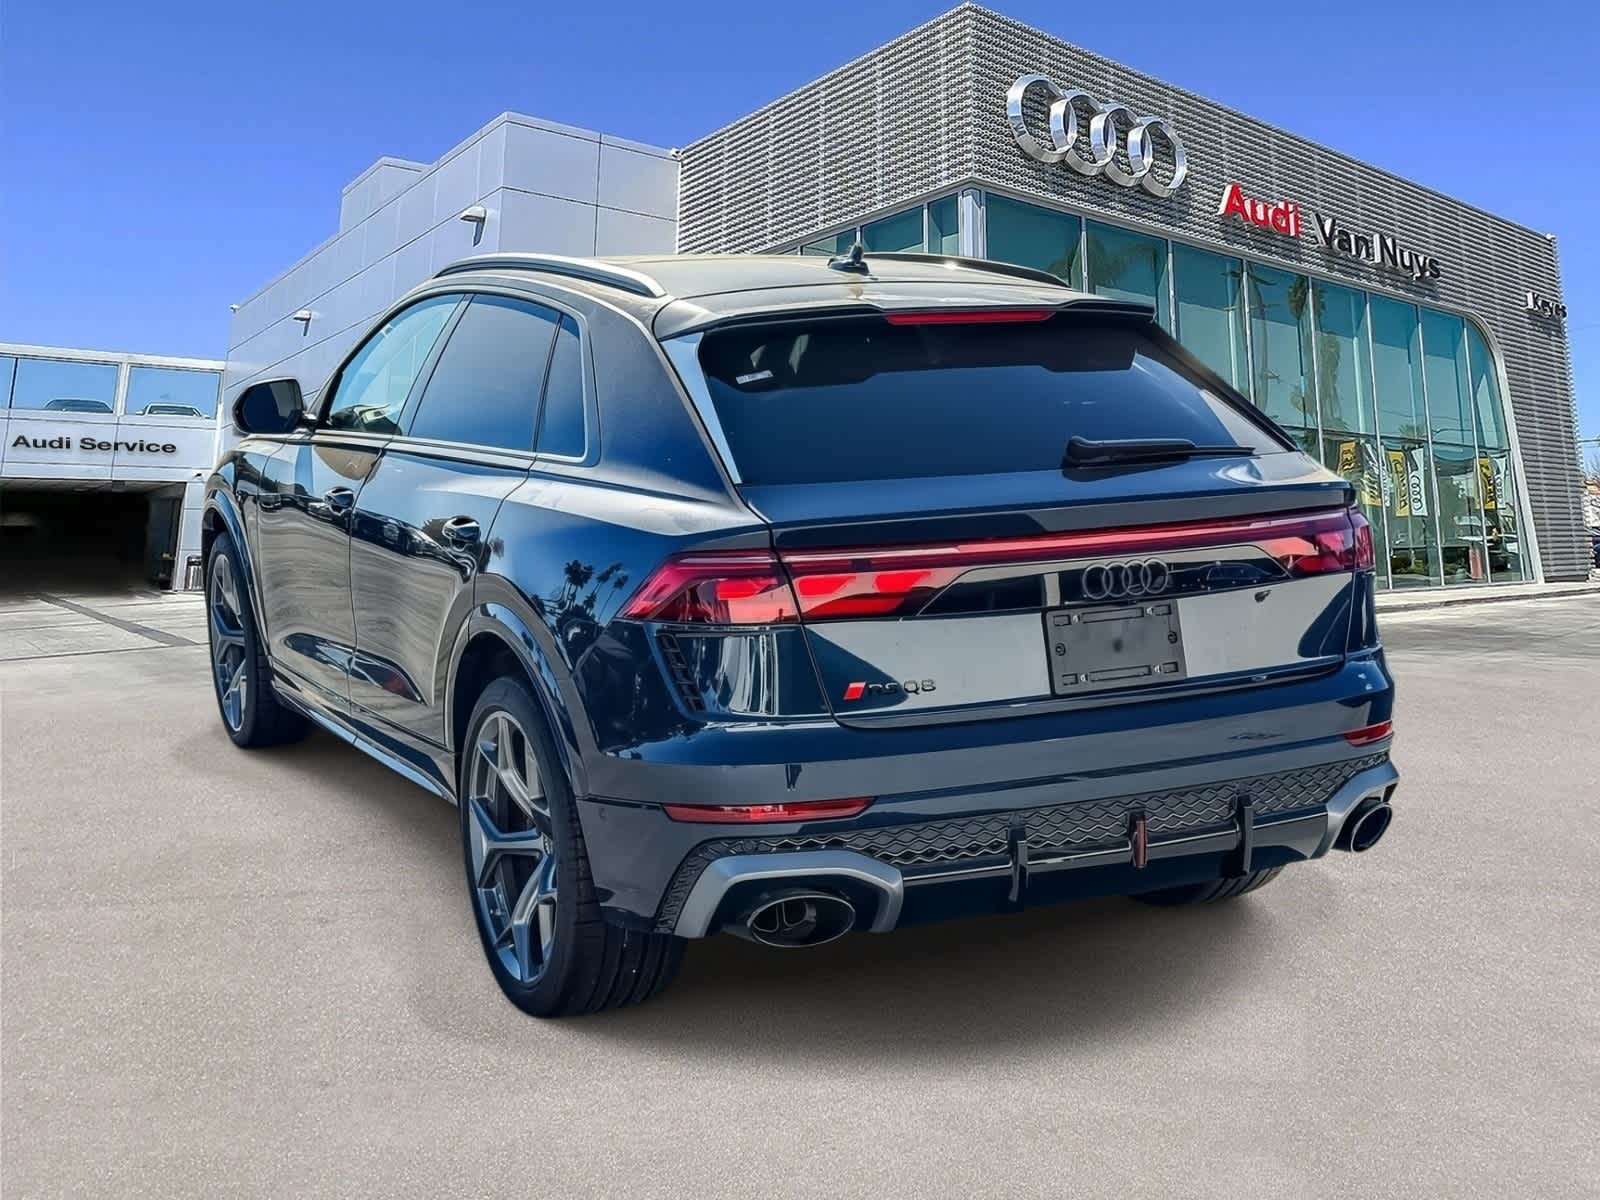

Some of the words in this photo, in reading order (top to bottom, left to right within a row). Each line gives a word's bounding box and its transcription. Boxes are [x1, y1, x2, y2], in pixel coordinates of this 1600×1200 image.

[1216, 181, 1302, 238] Audi
[1312, 212, 1371, 259] Van
[1373, 232, 1441, 281] Nuys
[12, 434, 71, 449] Audi
[79, 437, 177, 454] Service
